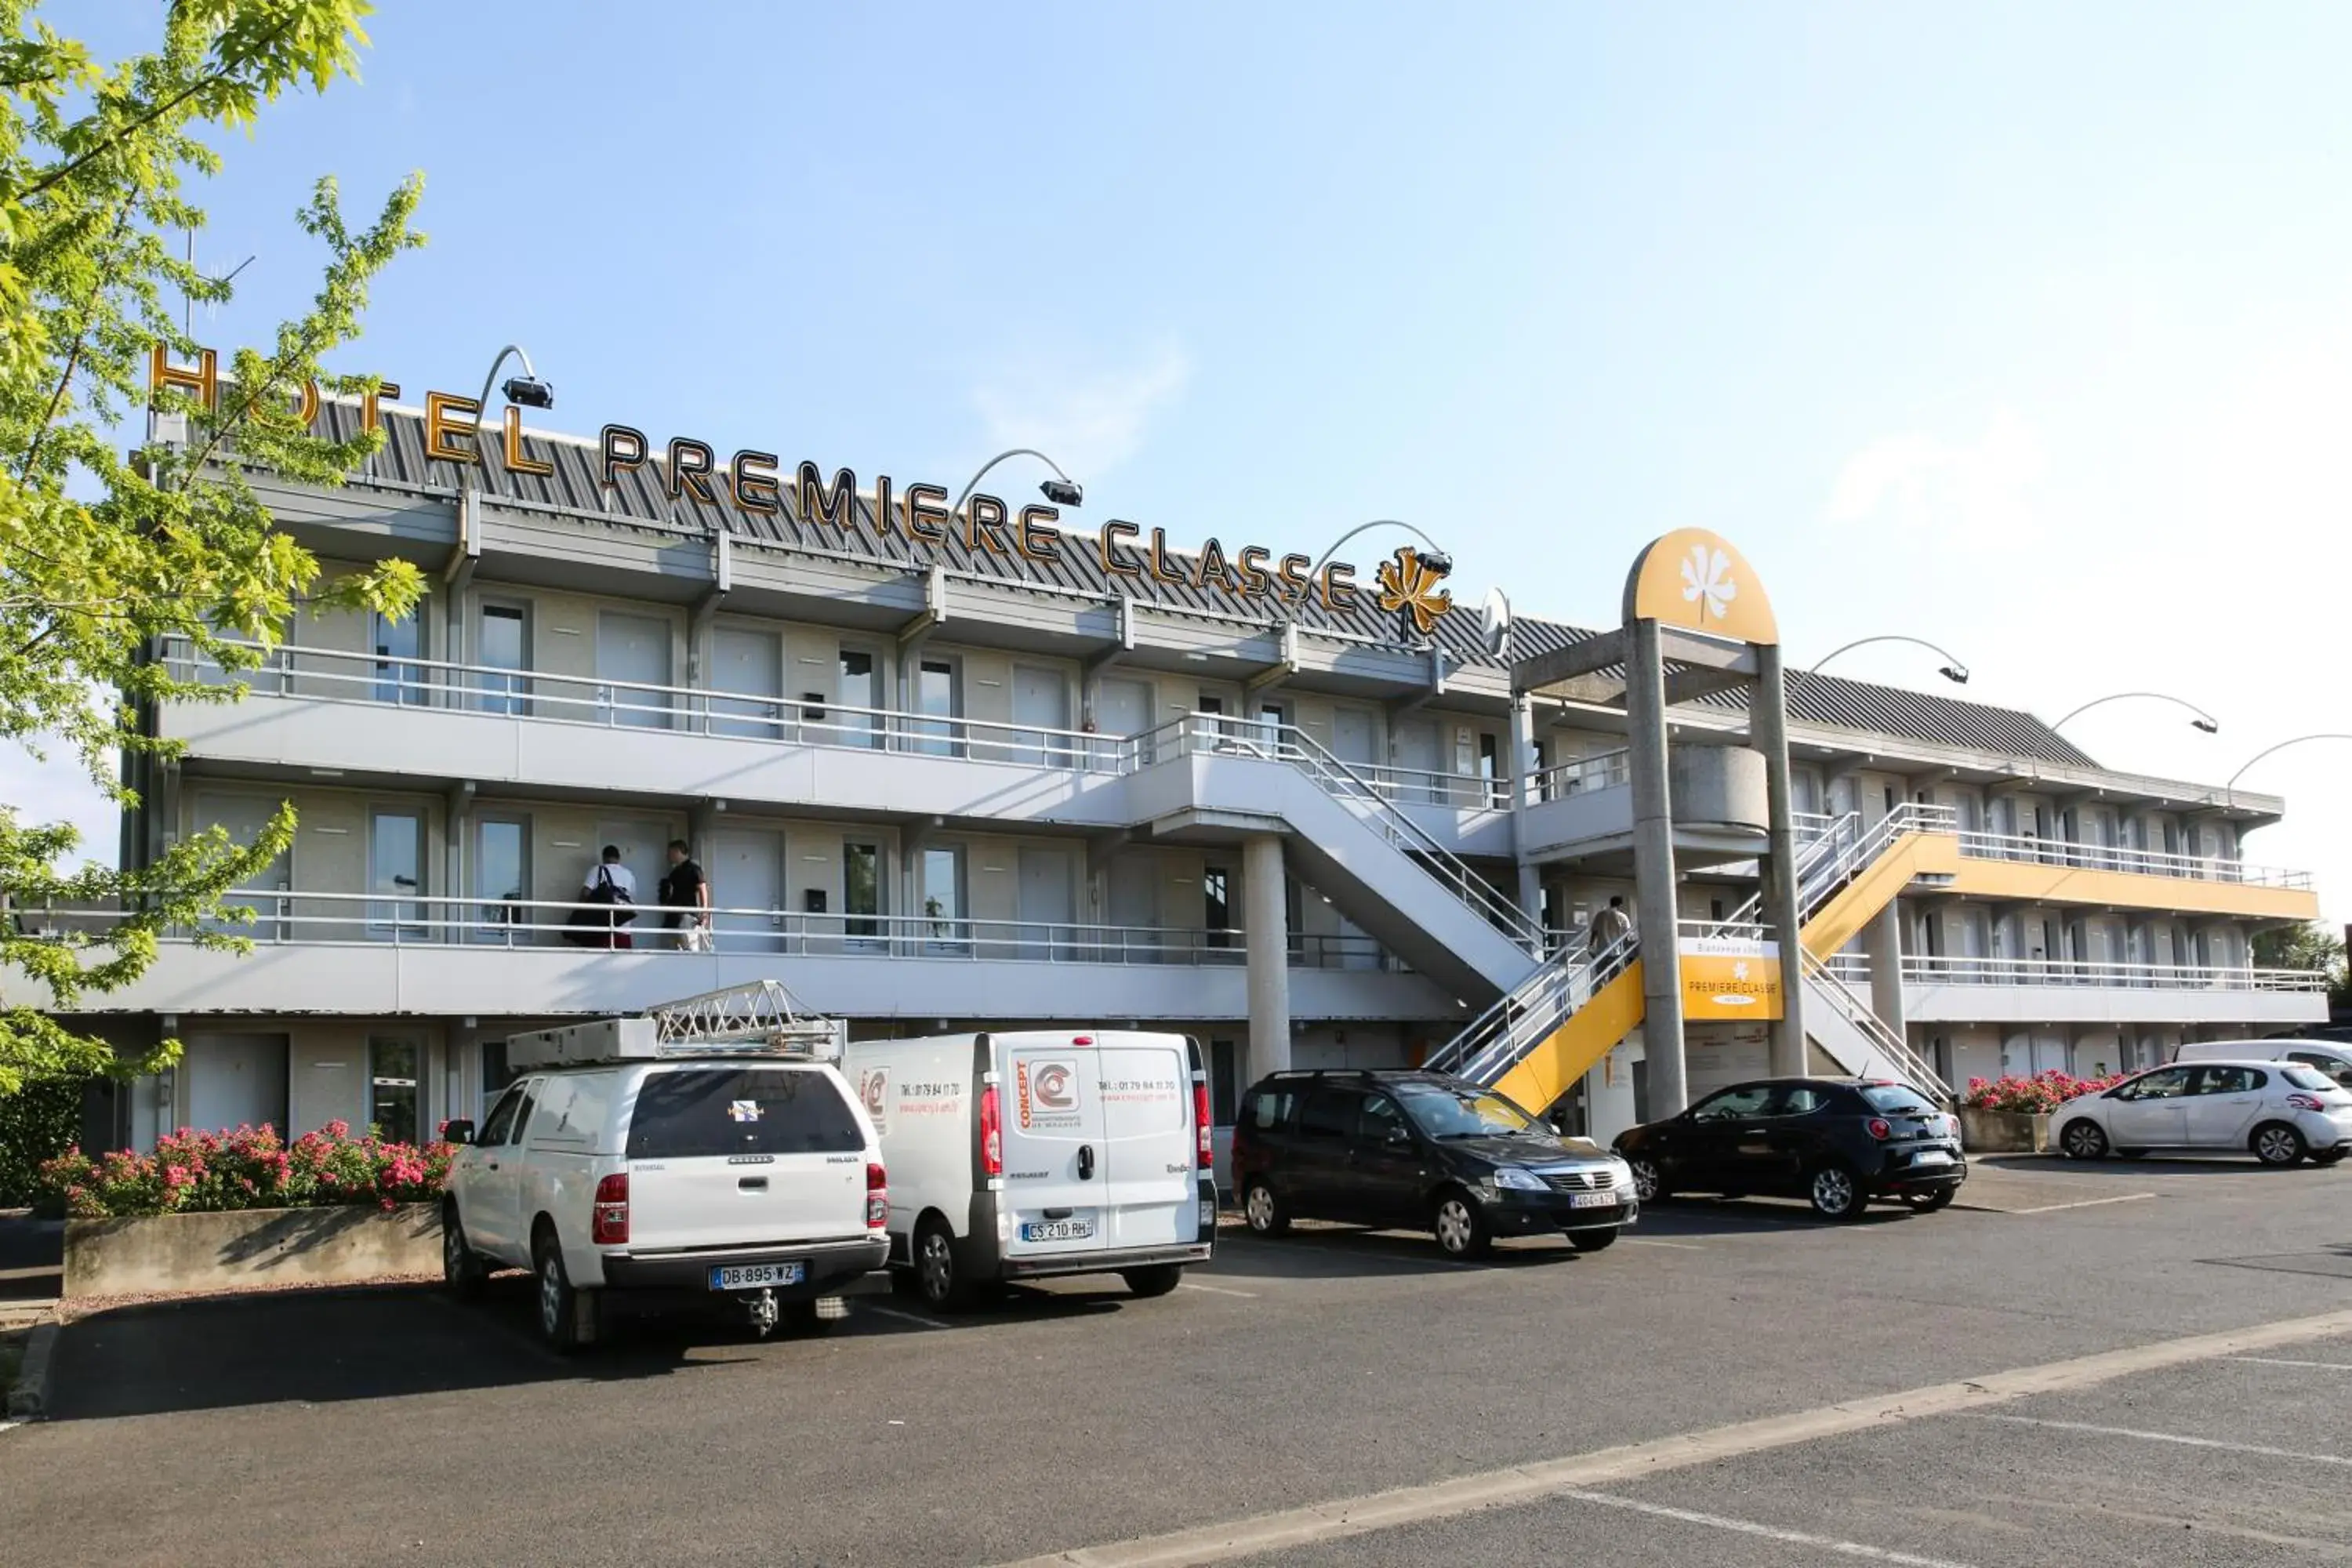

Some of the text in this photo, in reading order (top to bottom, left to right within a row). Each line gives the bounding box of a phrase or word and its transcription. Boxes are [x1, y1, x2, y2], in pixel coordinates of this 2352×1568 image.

[149, 339, 1356, 613] HOTEL PREMIERE CLASSE
[1689, 981, 1777, 994] PREMIERE CLASSE
[1017, 1061, 1030, 1129] CONCEPT
[722, 1265, 793, 1285] DB-895-WZ
